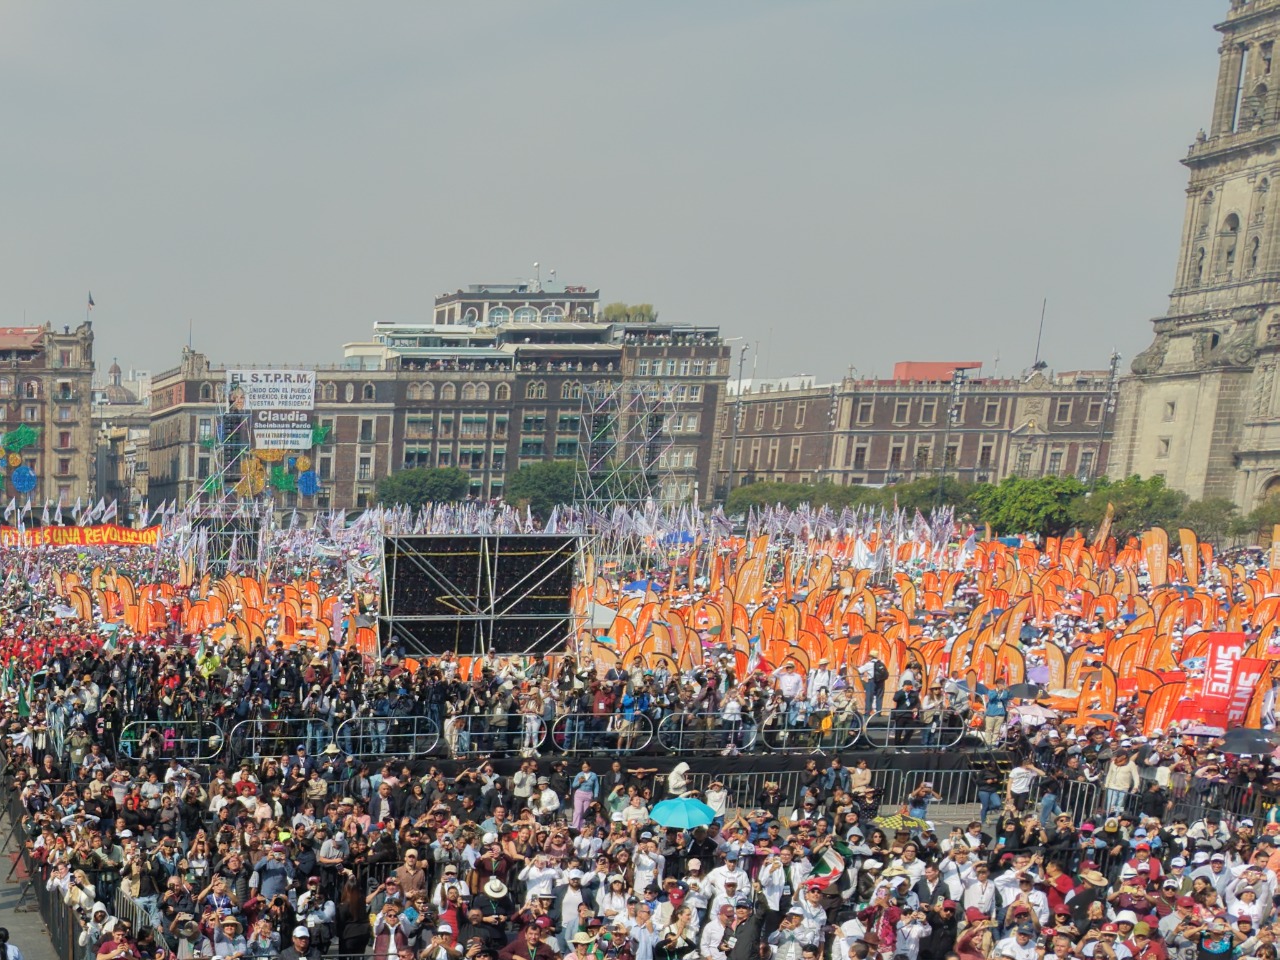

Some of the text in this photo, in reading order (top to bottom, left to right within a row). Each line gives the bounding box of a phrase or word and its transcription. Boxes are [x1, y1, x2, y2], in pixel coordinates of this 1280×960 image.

[231, 373, 312, 383] EL S.T.P.R.M.
[258, 411, 308, 422] Claudia
[52, 528, 80, 545] UNA
[1211, 645, 1241, 693] SNTE
[1228, 672, 1260, 720] SNTE
